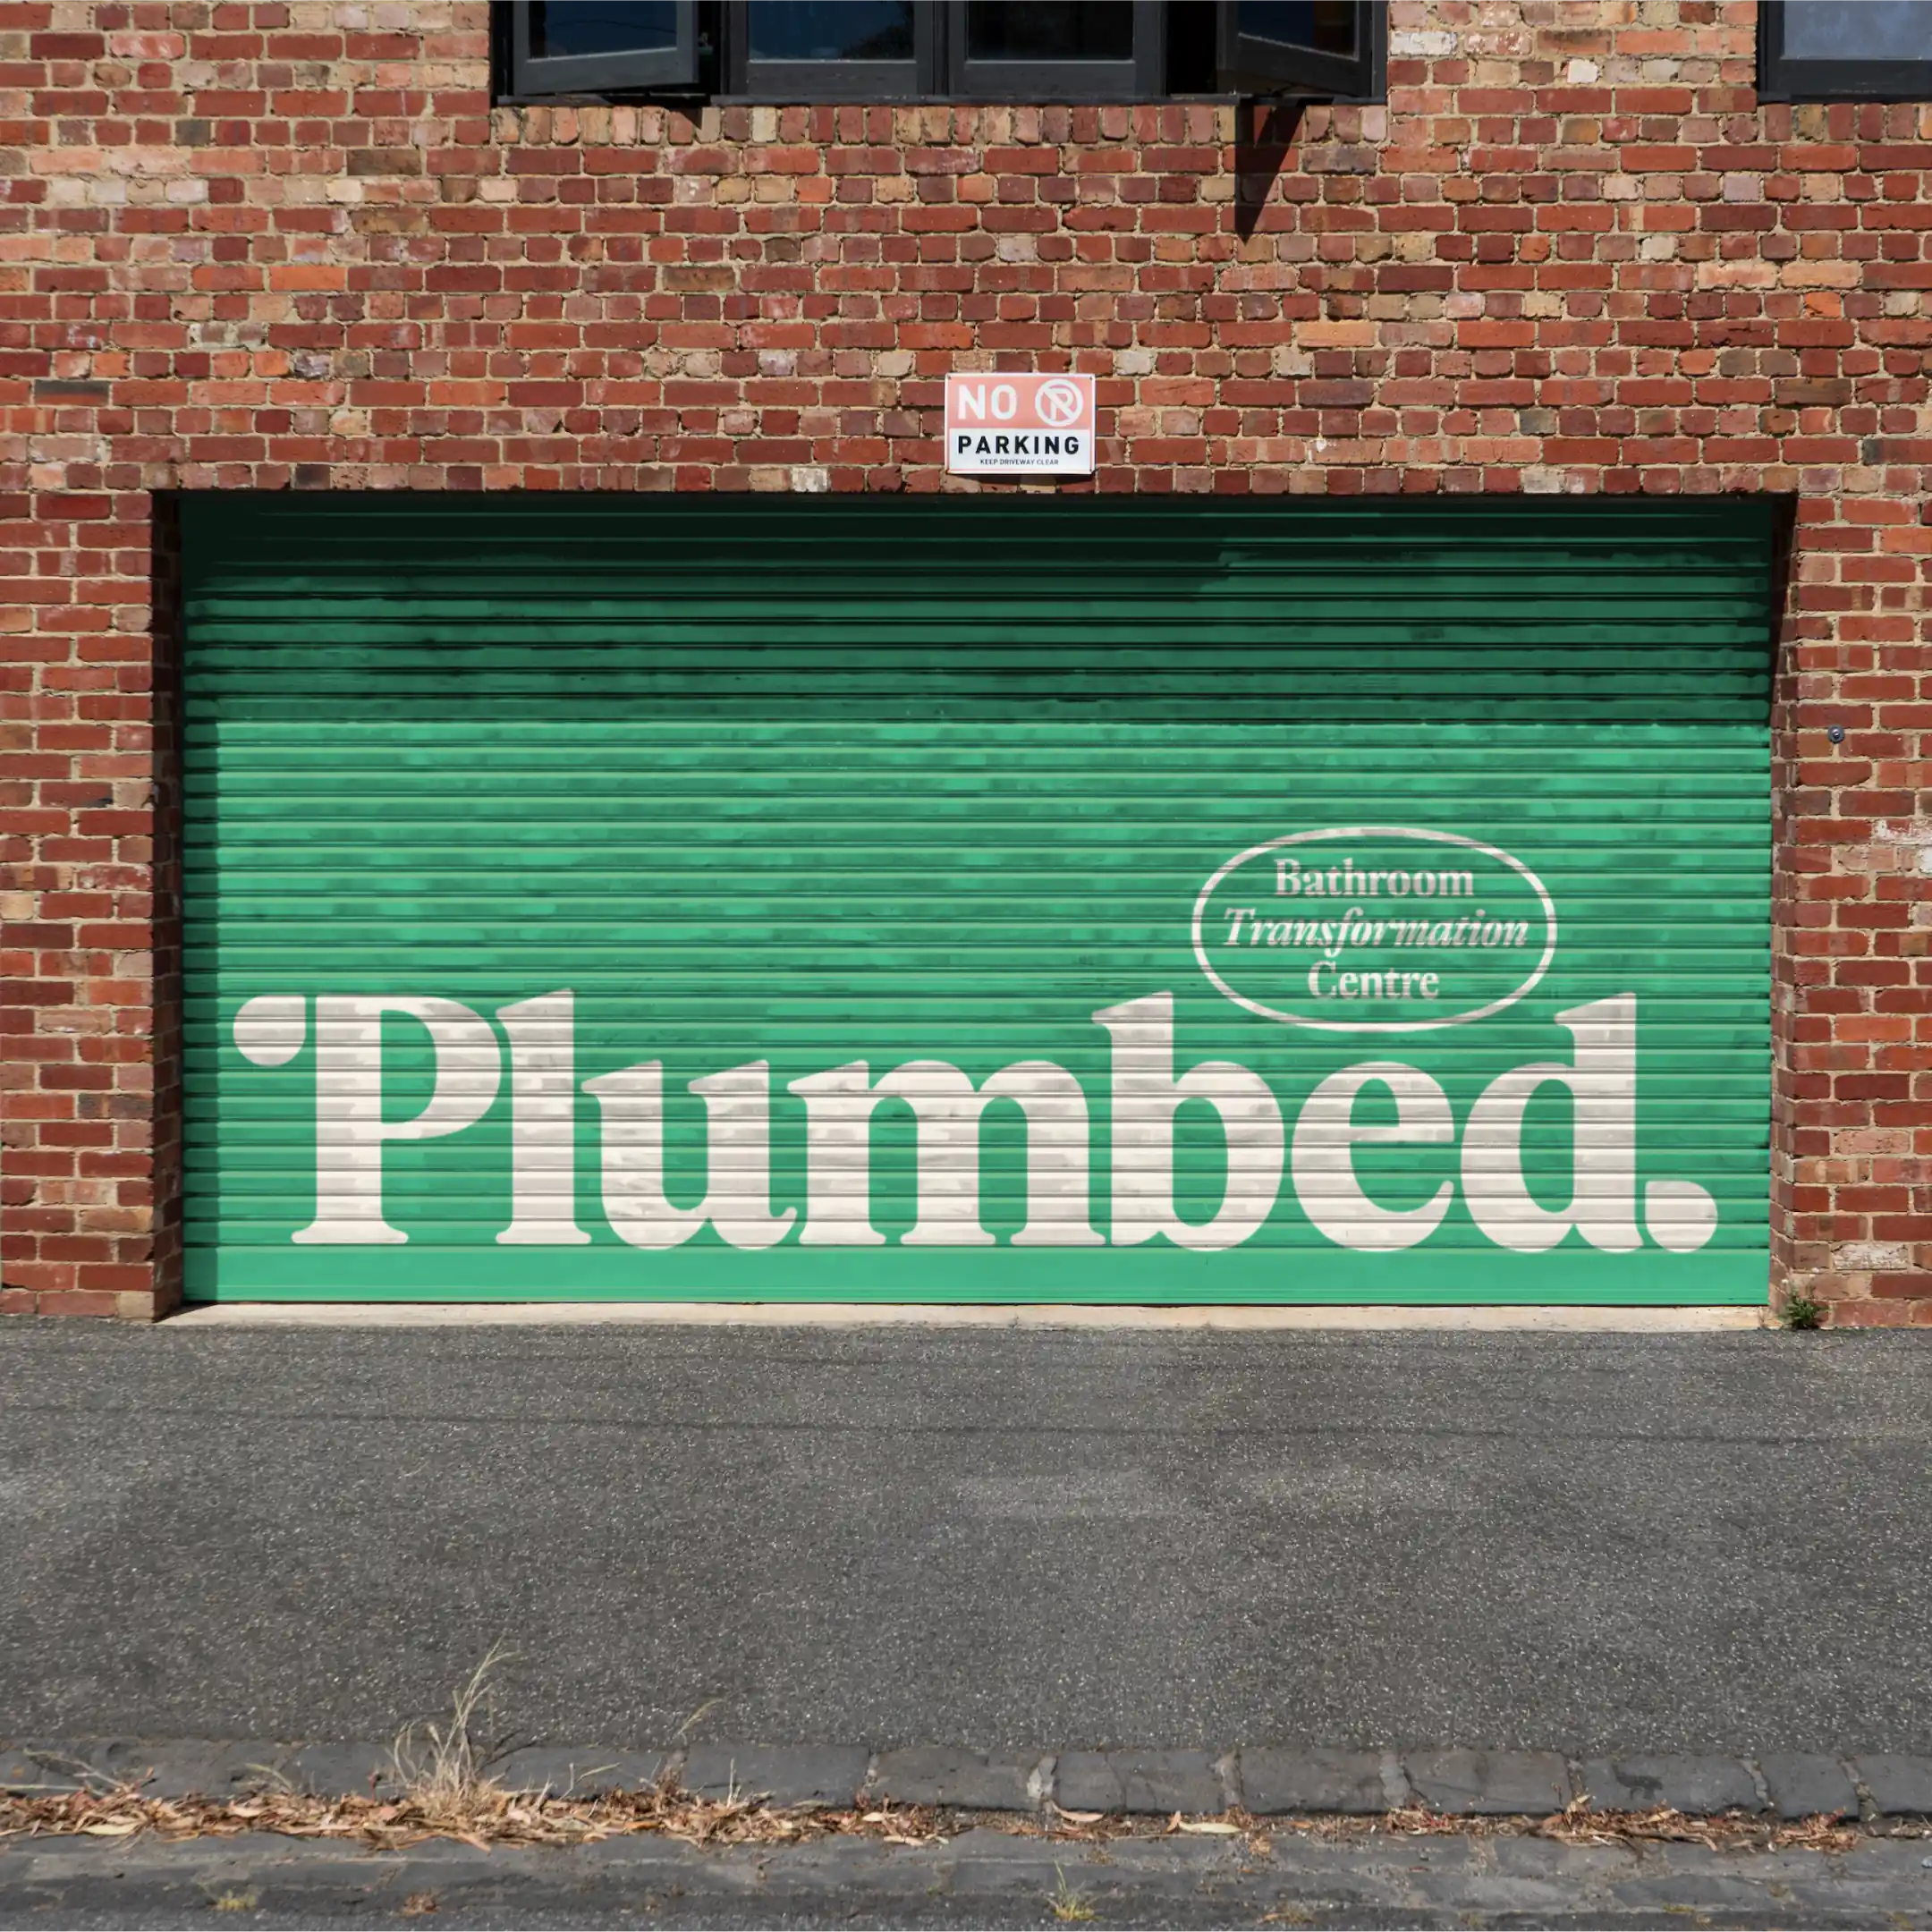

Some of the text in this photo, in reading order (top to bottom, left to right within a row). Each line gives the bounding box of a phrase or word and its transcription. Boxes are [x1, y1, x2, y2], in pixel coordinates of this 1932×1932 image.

[958, 384, 1017, 419] NO
[958, 436, 1079, 454] PARKING
[1274, 857, 1474, 897] Bathroom
[1223, 906, 1530, 958] Transformation
[1308, 960, 1440, 1000] Centre
[233, 988, 1718, 1253] Plumbed.
